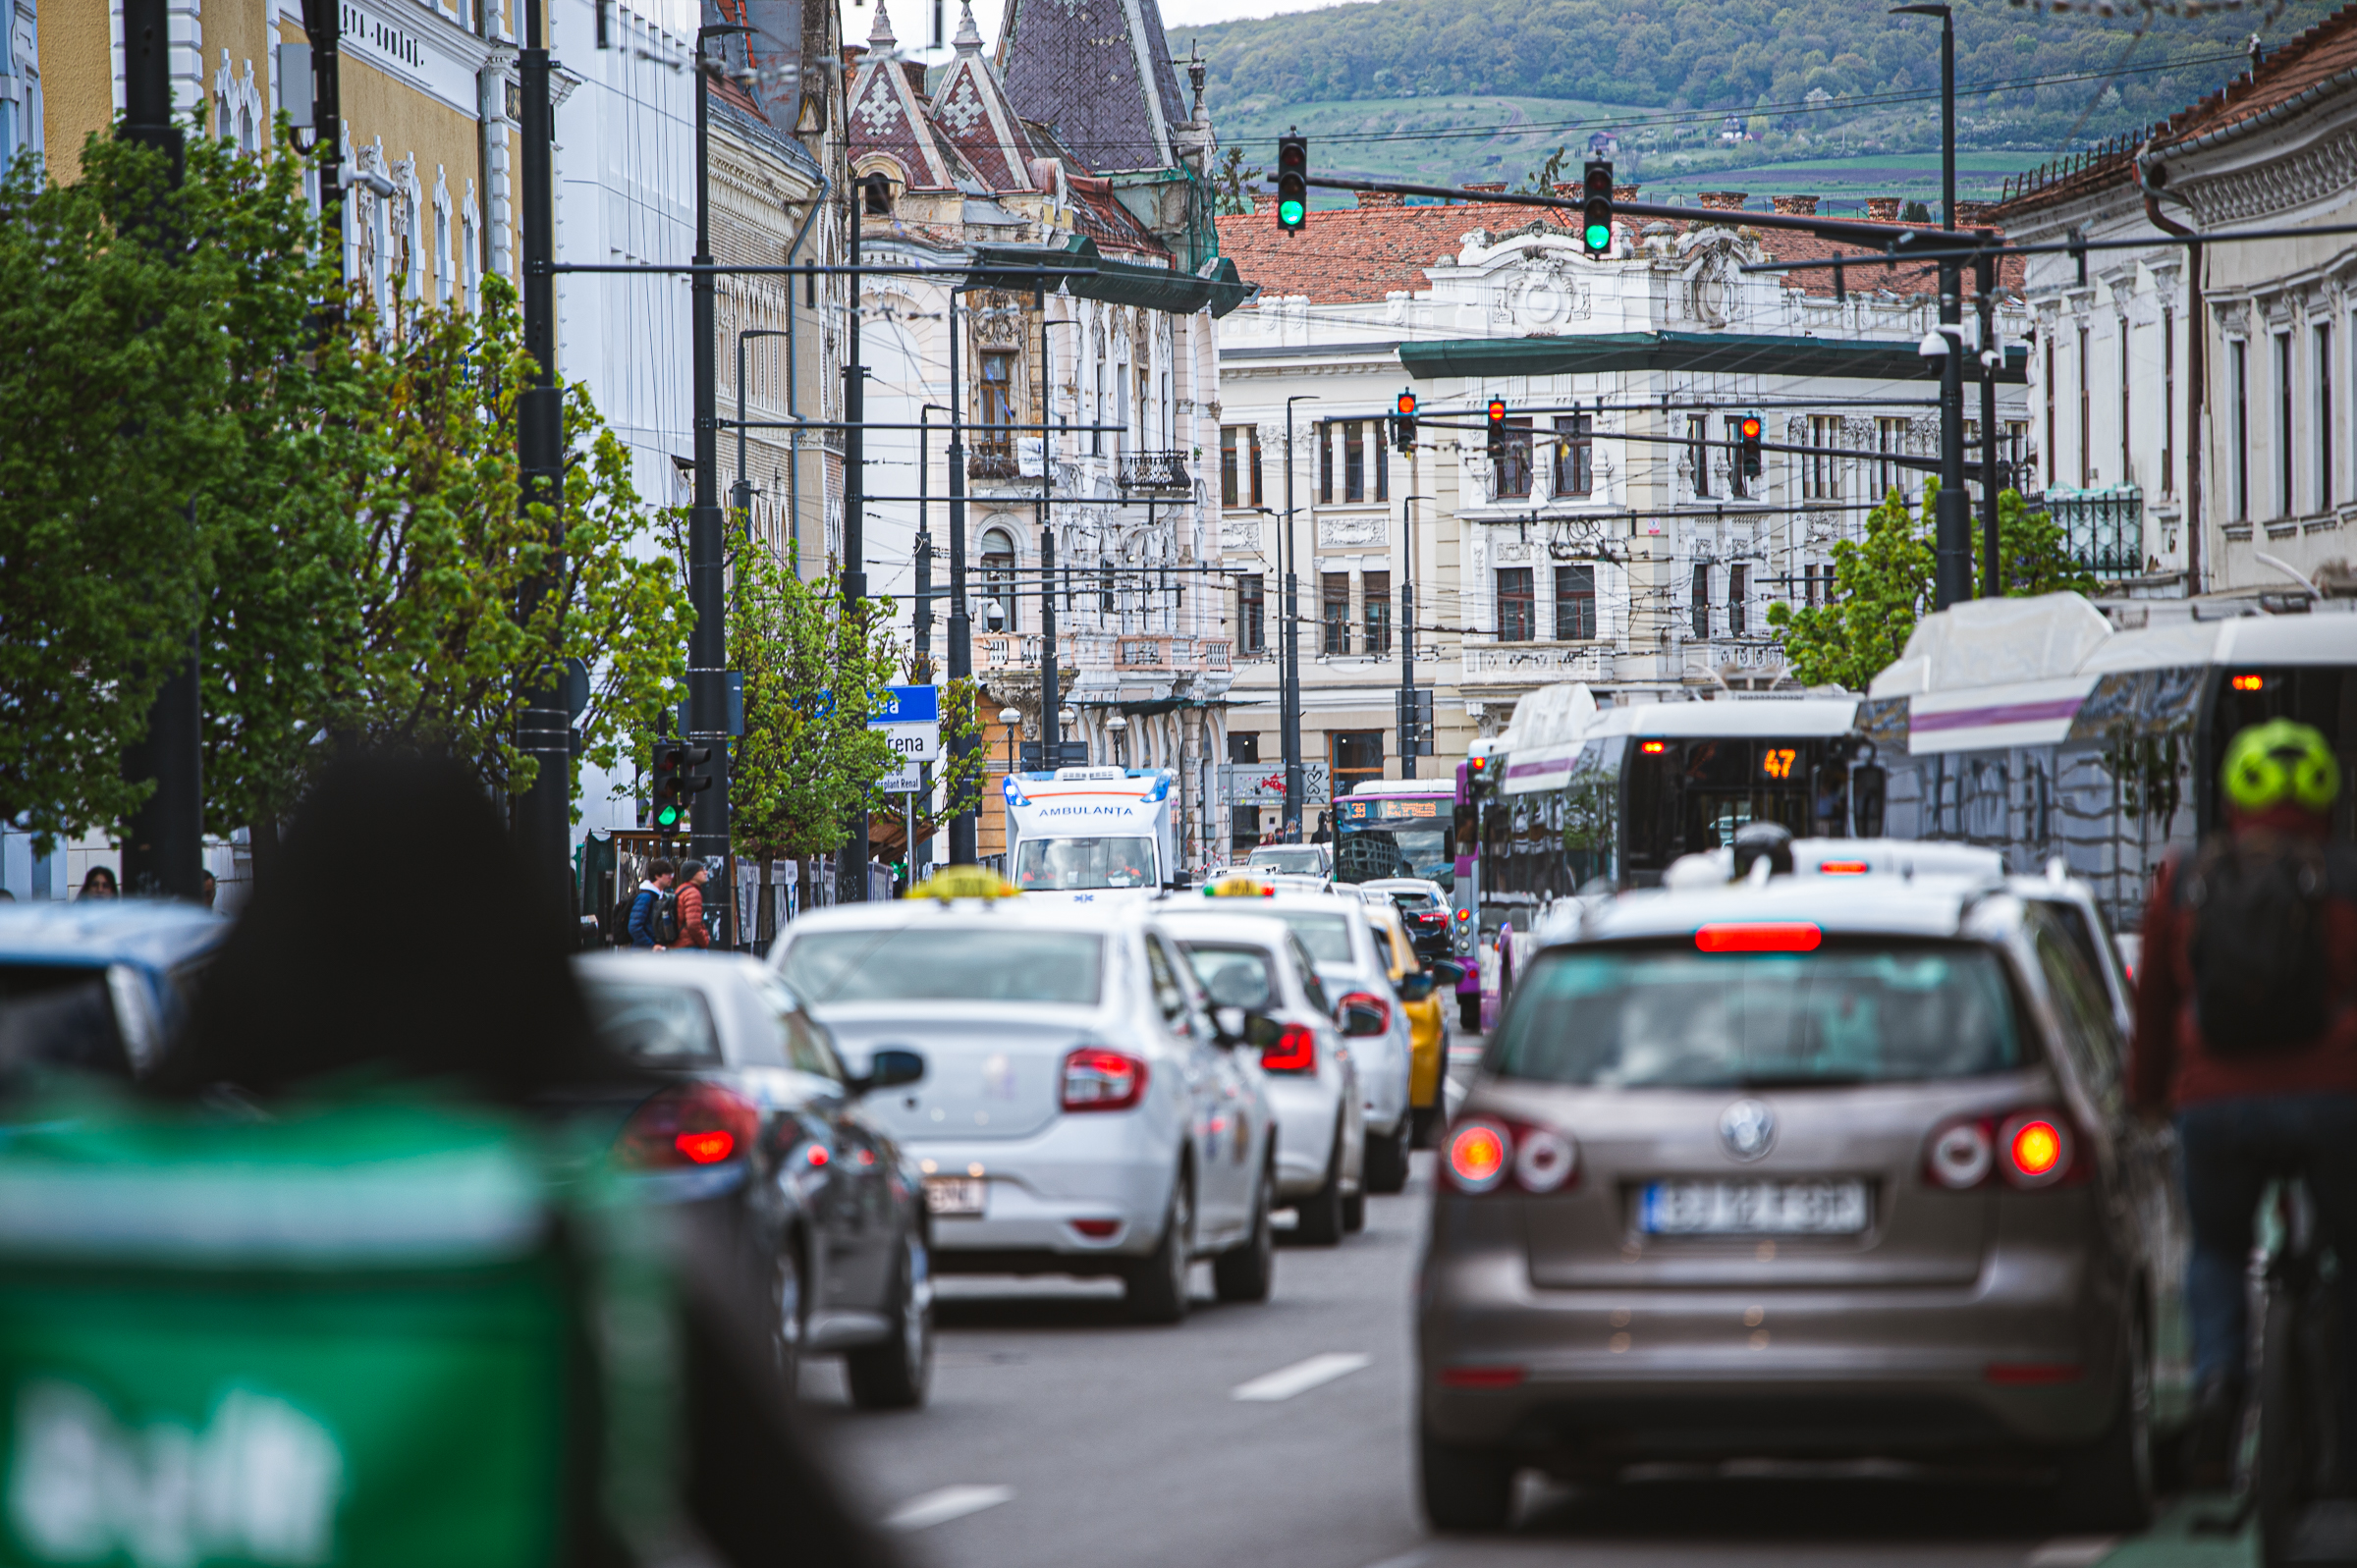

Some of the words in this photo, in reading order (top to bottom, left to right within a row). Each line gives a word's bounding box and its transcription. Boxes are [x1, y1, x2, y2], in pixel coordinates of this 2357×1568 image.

[887, 737, 924, 753] rena
[1764, 748, 1796, 779] 47
[901, 778, 918, 788] Renal
[1039, 806, 1133, 818] AMBULANȚA
